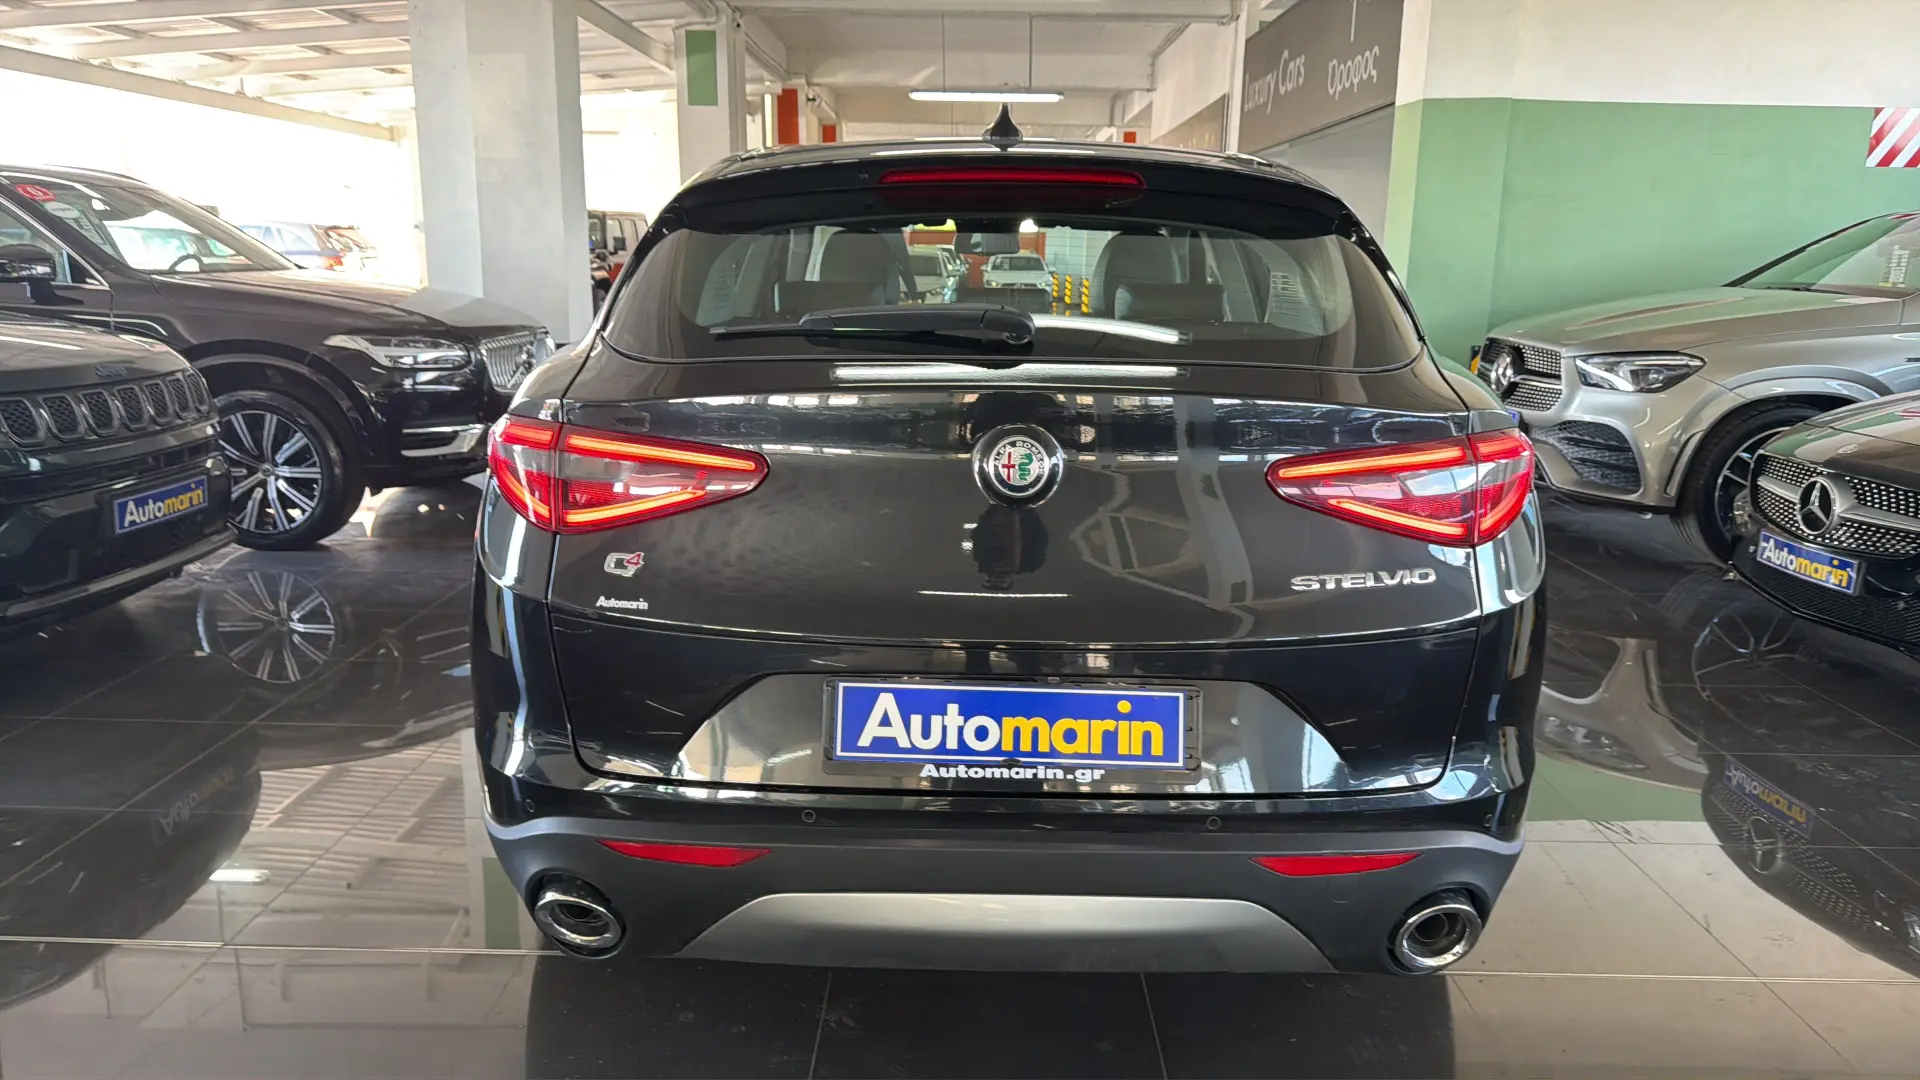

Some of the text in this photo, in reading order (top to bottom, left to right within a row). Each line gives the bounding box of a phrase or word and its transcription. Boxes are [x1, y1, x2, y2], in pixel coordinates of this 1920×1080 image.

[1244, 49, 1305, 114] Luxury Cars
[124, 483, 204, 527] Automarin
[1290, 567, 1436, 591] STELVIO
[1763, 538, 1849, 587] Automarin
[595, 595, 649, 610] Automarin
[856, 692, 1164, 756] Automarin
[919, 763, 1106, 783] Automarin.gr
